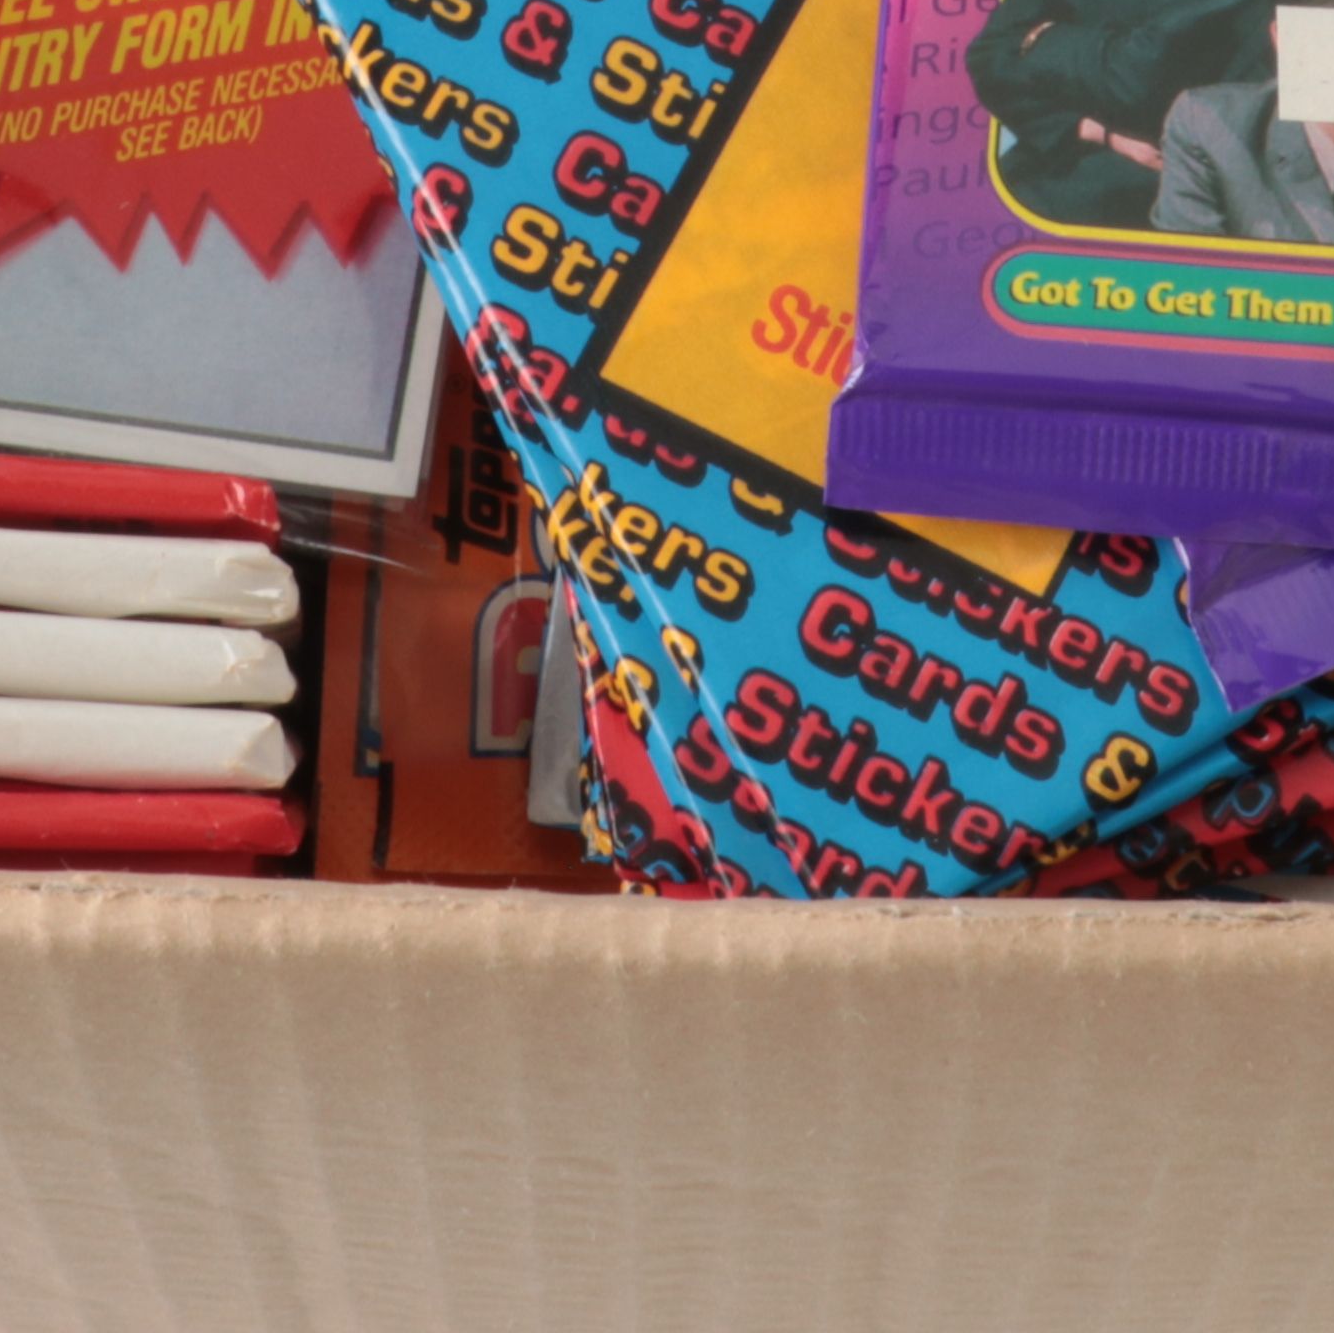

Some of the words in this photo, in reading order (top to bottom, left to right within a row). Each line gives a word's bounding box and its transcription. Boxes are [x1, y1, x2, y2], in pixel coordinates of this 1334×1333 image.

[110, 3, 253, 75] FORM
[54, 81, 203, 140] PURCHASE
[210, 52, 345, 108] NECESSA
[115, 124, 168, 163] SEE
[176, 104, 264, 150] BACK)
[1010, 270, 1081, 308] Got
[1091, 277, 1136, 311] To
[1147, 279, 1217, 317] Get
[1226, 285, 1334, 326] Them
[801, 584, 1065, 765] Cards
[729, 671, 1049, 870] Sticker
